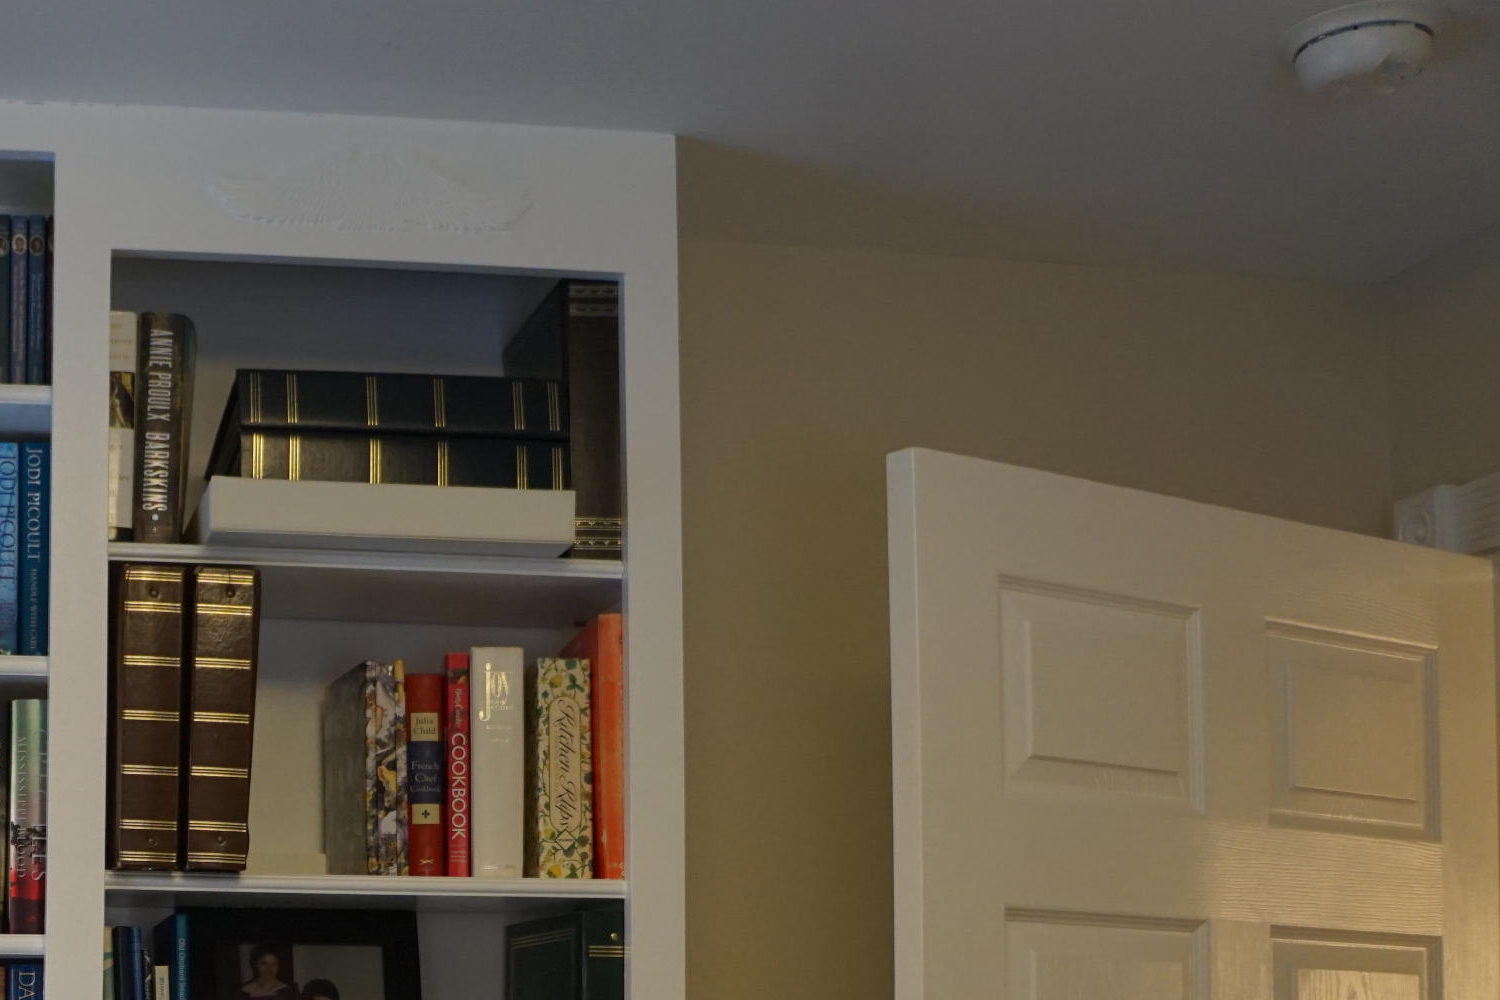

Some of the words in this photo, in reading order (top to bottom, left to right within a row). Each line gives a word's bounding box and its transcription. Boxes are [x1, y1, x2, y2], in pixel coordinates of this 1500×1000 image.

[148, 328, 173, 368] ANNIE
[146, 371, 172, 422] PROULX
[26, 446, 43, 484] JODI
[142, 431, 170, 512] BARKSKINS
[27, 492, 41, 563] PICOULT
[555, 700, 576, 772] Kitchen
[18, 737, 28, 819] MISSISSIPPI
[451, 733, 466, 841] COOKBOOK
[556, 776, 577, 829] Klips
